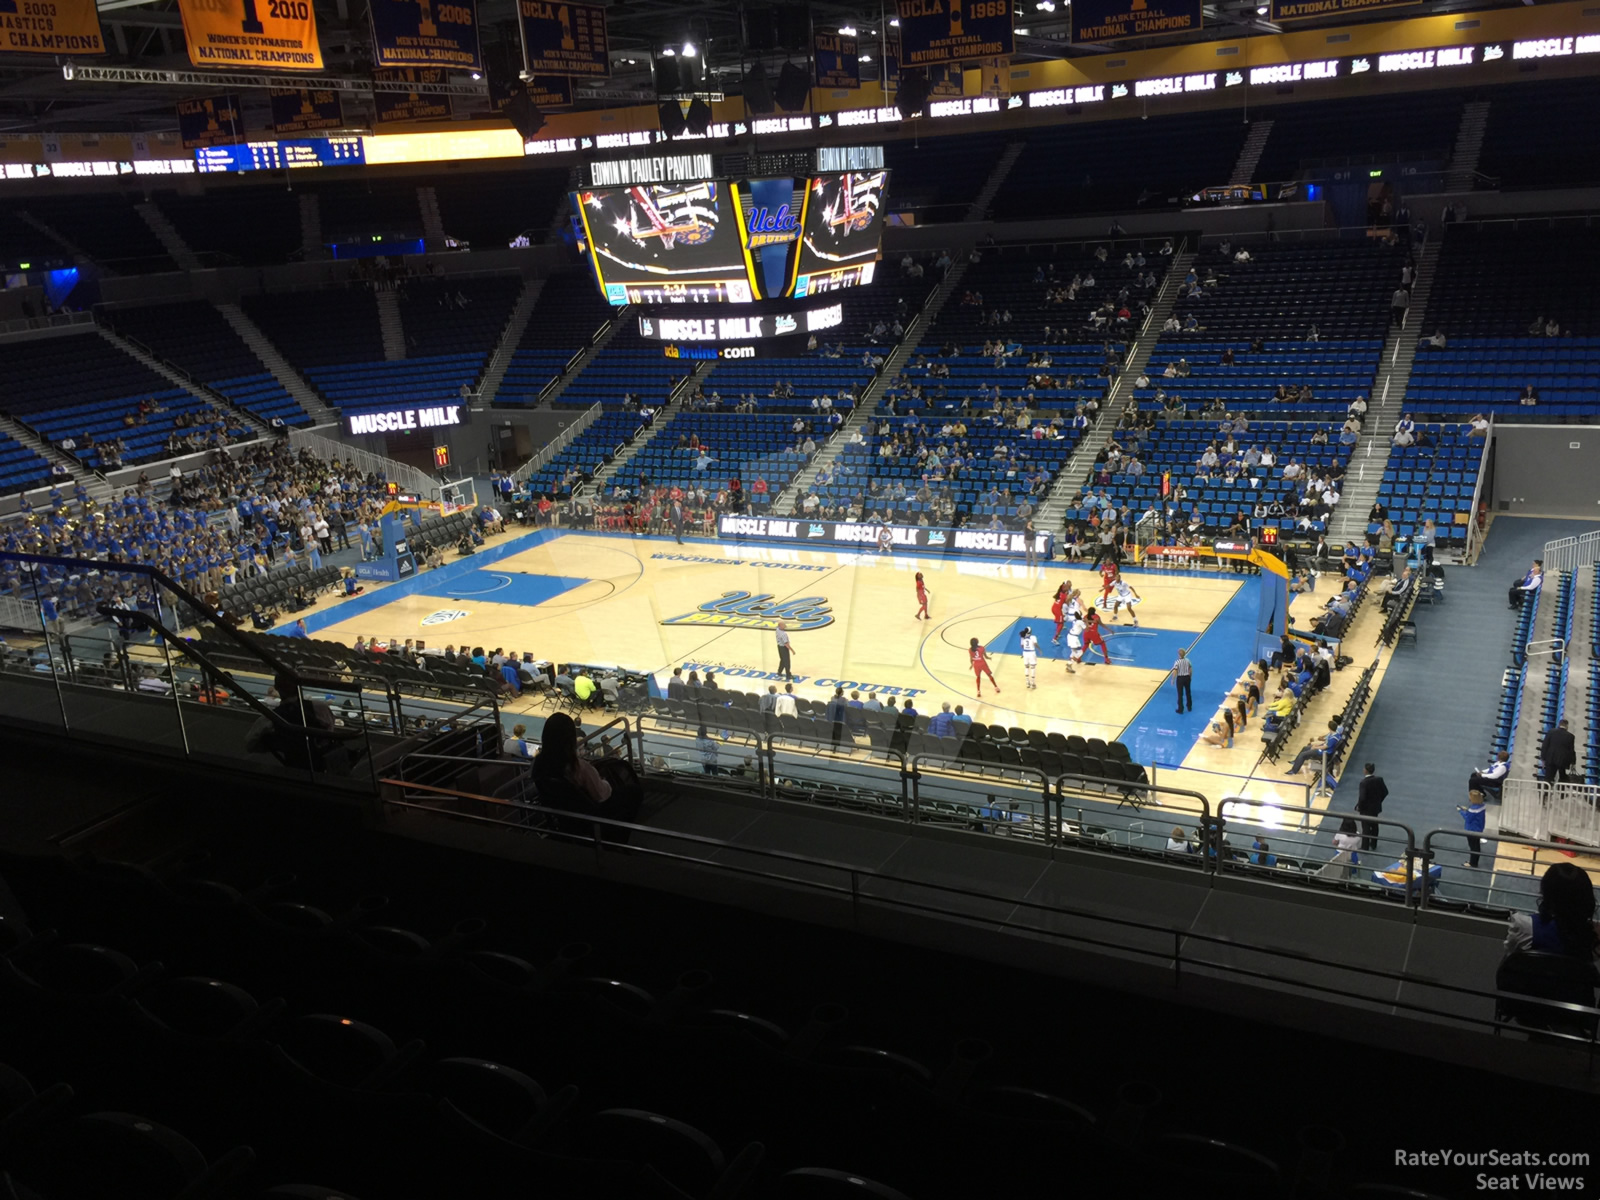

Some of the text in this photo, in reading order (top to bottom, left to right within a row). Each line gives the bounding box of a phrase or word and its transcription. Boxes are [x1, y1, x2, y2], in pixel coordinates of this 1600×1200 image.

[24, 2, 57, 16] 2003
[268, 0, 309, 20] 2010
[438, 4, 472, 25] 2006
[522, 0, 555, 19] UCLA
[899, 0, 943, 18] UCLA
[969, 1, 1007, 19] 1969
[1279, 0, 1339, 16] NATIONAL
[1105, 10, 1166, 24] BASKETBALL
[1080, 15, 1191, 40] NATIONAL CHAMPIONS
[9, 32, 100, 49] CHAMPIONS
[207, 33, 303, 49] WOMEN'S GYMNASTICS
[419, 37, 460, 49] VOLLEYBALL
[929, 35, 982, 47] BASKETBALL
[198, 46, 315, 64] NATIONAL CHAMPIONS
[382, 47, 474, 63] NATIONAL CHAMPIONS
[910, 49, 949, 62] NATIONAL
[952, 42, 1003, 58] CHAMPIONS
[533, 60, 605, 72] NATIONAL CHAMPIONS
[419, 69, 442, 83] 1967
[930, 100, 972, 118] MUSCLE
[1029, 89, 1074, 108] MUSCLE
[1075, 86, 1105, 103] MILK
[1135, 77, 1183, 97] MUSCLE
[1184, 73, 1217, 92] MILK
[1250, 64, 1302, 85] MUSCLE
[1303, 60, 1339, 80] MILK
[1378, 50, 1436, 73] MUSCLE
[1436, 46, 1475, 67] MILK
[1512, 37, 1575, 60] MUSCLE
[178, 102, 202, 115] UCLA
[590, 153, 713, 186] EDWIN W PAULEY PAVILION
[750, 231, 797, 248] BRUINS
[629, 289, 642, 304] 10
[658, 319, 717, 342] MUSCLE
[717, 316, 765, 340] MILK
[350, 406, 460, 435] MUSCLE MILK
[720, 517, 767, 537] MUSCLE
[768, 520, 800, 538] MILK
[834, 524, 880, 543] MUSCL
[954, 531, 1009, 551] MUSCLE
[1264, 534, 1275, 542] 11
[650, 553, 748, 567] WOODEN
[749, 560, 832, 572] COURT
[372, 568, 390, 577] Health
[974, 651, 980, 659] 3
[679, 662, 927, 698] WOODEN COURT
